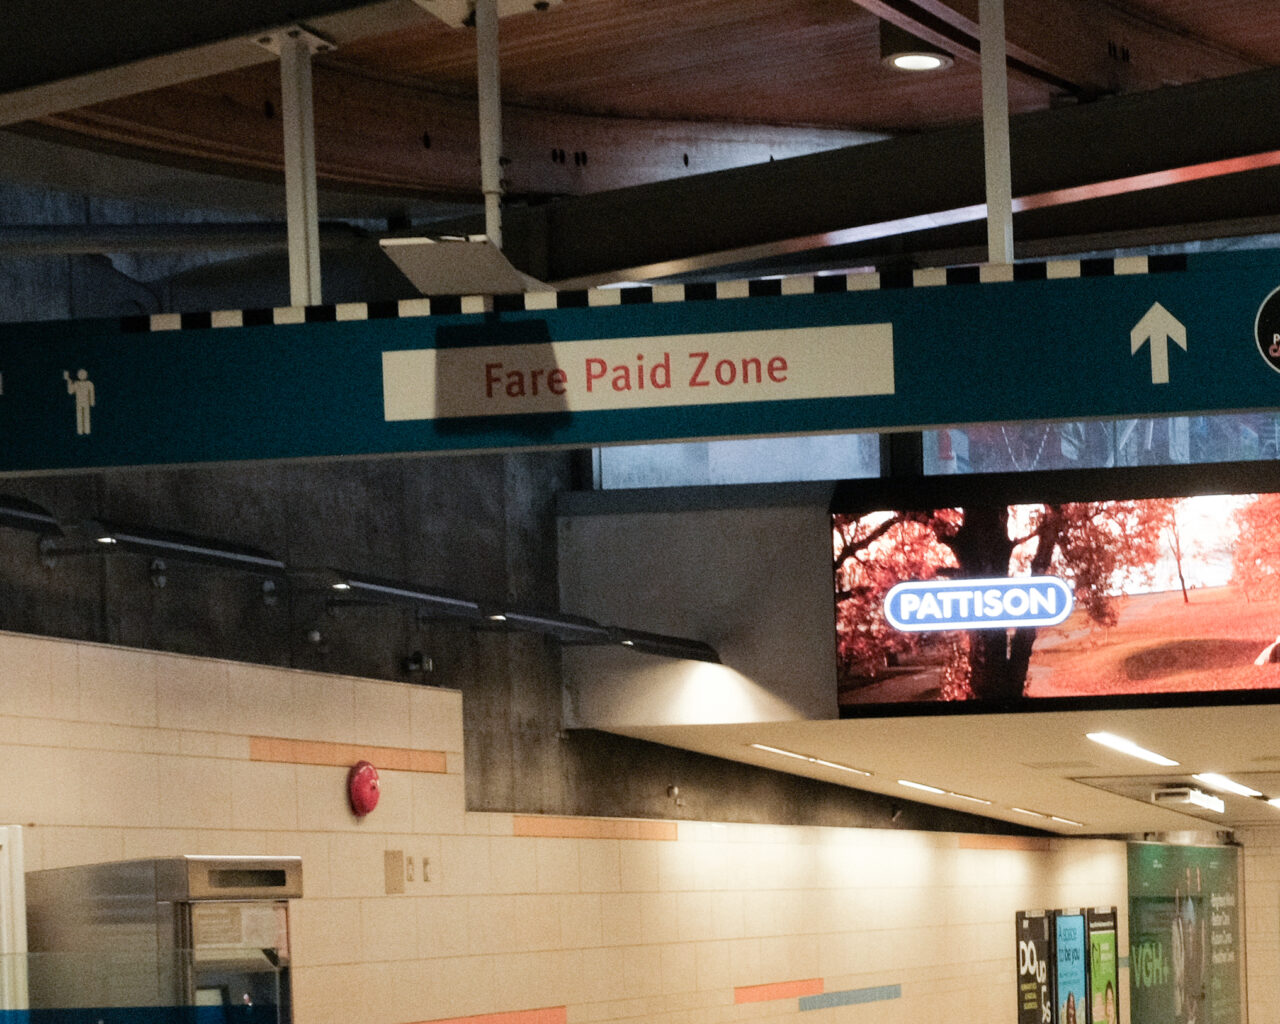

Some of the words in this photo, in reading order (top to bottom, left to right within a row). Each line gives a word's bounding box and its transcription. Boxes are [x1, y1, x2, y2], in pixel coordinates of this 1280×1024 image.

[485, 362, 567, 398] Fare
[585, 352, 671, 393] Paid
[688, 352, 788, 387] Zone
[900, 587, 1056, 620] PATTISON
